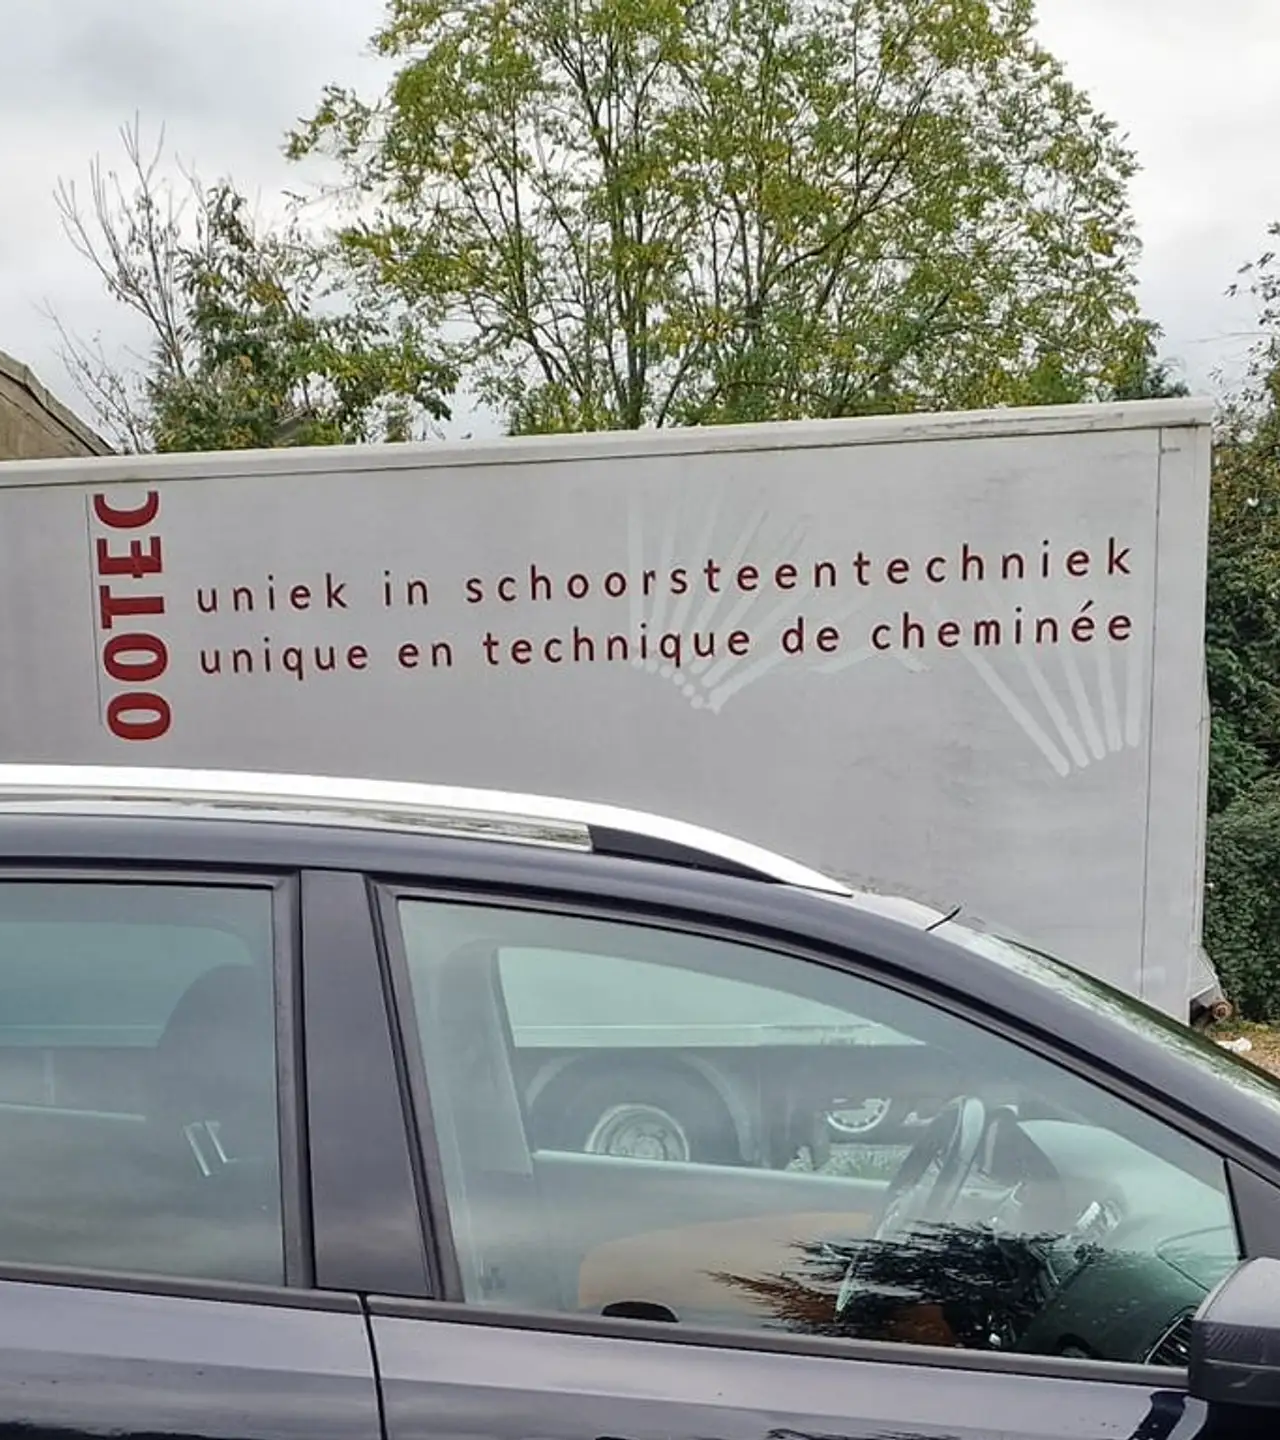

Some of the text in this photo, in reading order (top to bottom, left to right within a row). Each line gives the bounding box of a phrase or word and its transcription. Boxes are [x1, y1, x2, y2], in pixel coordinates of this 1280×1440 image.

[92, 490, 174, 742] OOTEC
[197, 538, 1131, 614] uniek in schoorsteentechniek
[199, 600, 1133, 681] unique en technique de cheminée
